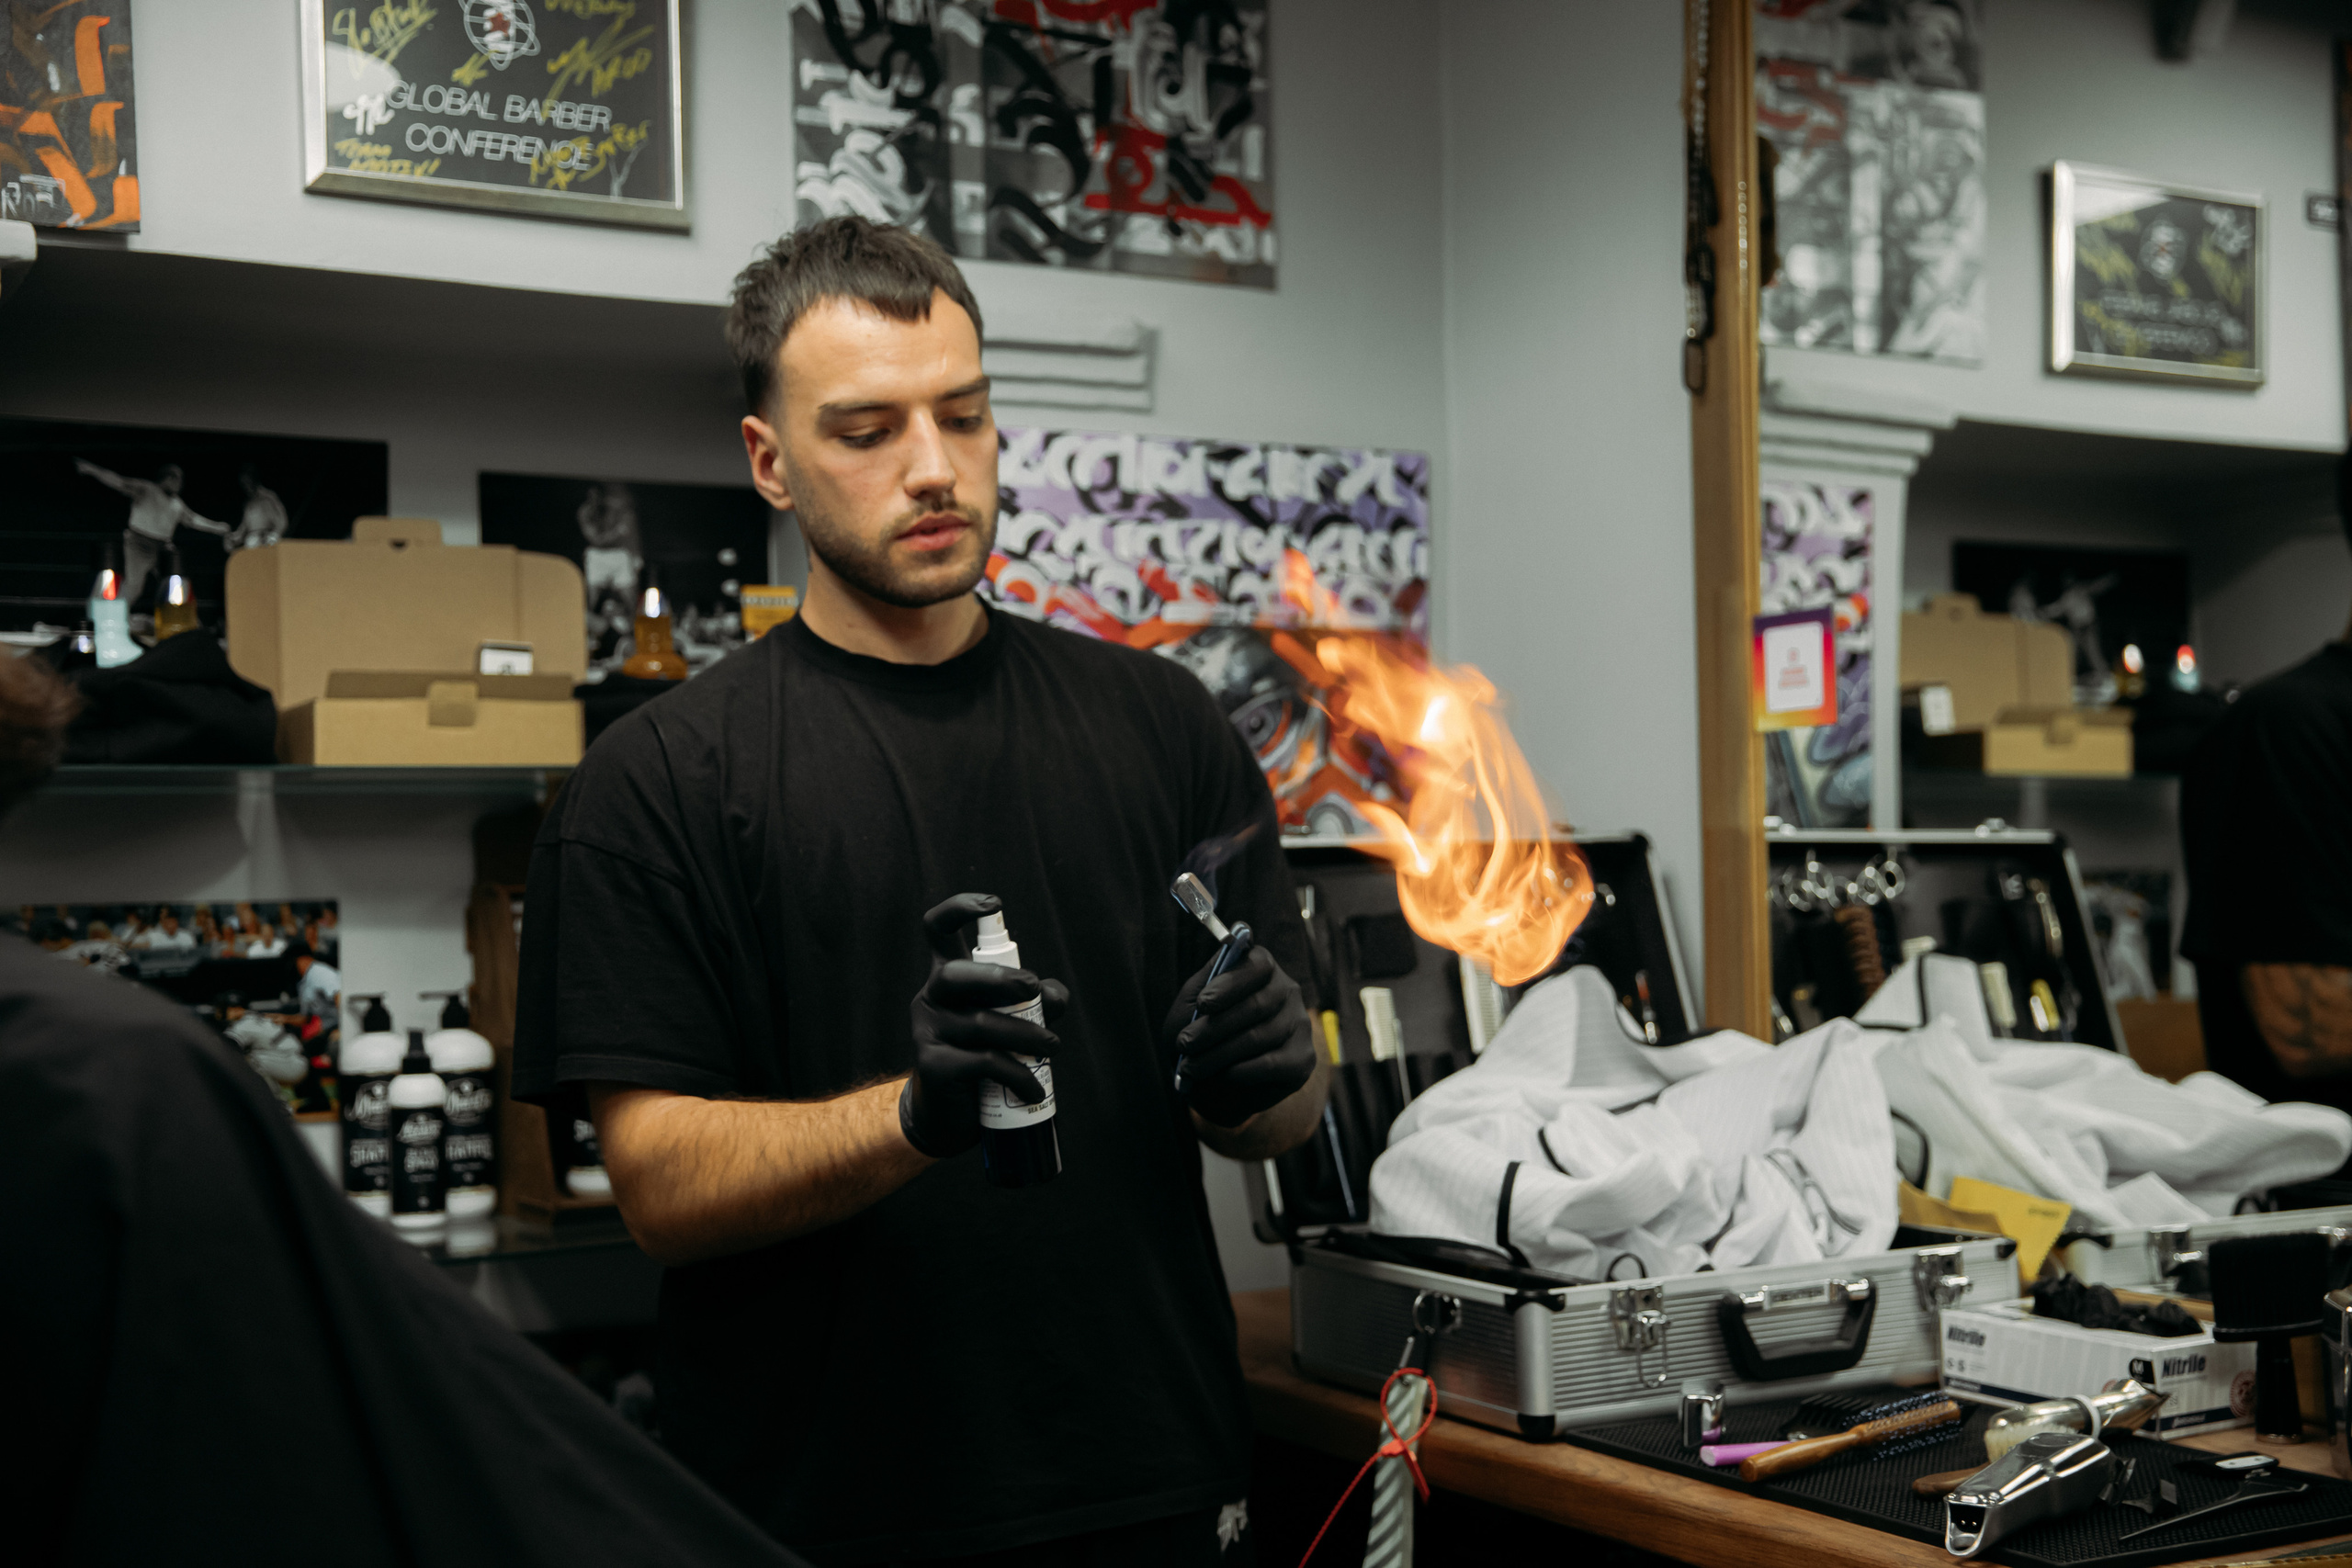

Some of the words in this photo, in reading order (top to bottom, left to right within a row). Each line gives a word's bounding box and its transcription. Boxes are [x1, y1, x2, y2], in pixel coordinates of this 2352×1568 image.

[386, 80, 498, 120] GLOBAL
[503, 94, 613, 133] BARBER
[405, 122, 594, 171] CONFERENCE
[2163, 1353, 2207, 1378] Nitrile
